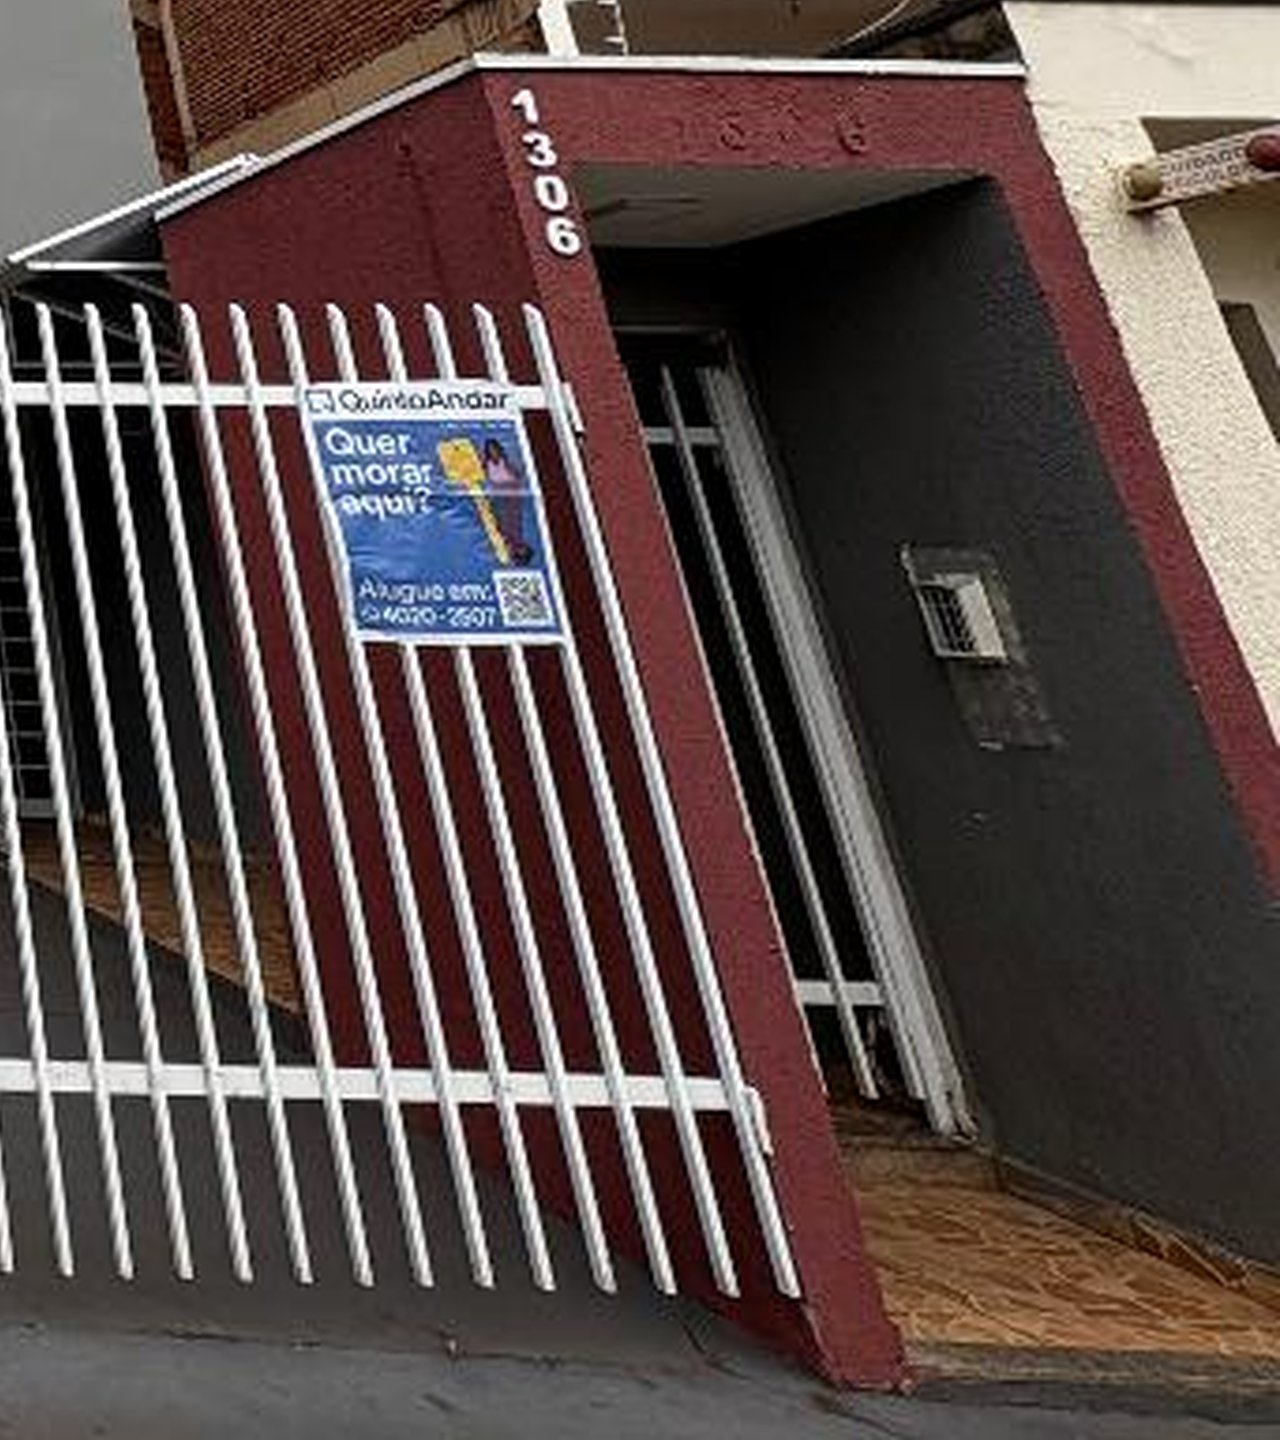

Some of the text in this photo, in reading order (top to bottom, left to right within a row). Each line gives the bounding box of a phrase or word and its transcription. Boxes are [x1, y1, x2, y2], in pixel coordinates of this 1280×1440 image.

[510, 89, 581, 256] 1306
[338, 388, 510, 413] QuintoAndar
[325, 427, 411, 455] Quer
[329, 461, 432, 486] morar
[338, 487, 433, 521] aqui?
[358, 580, 444, 606] Alugue
